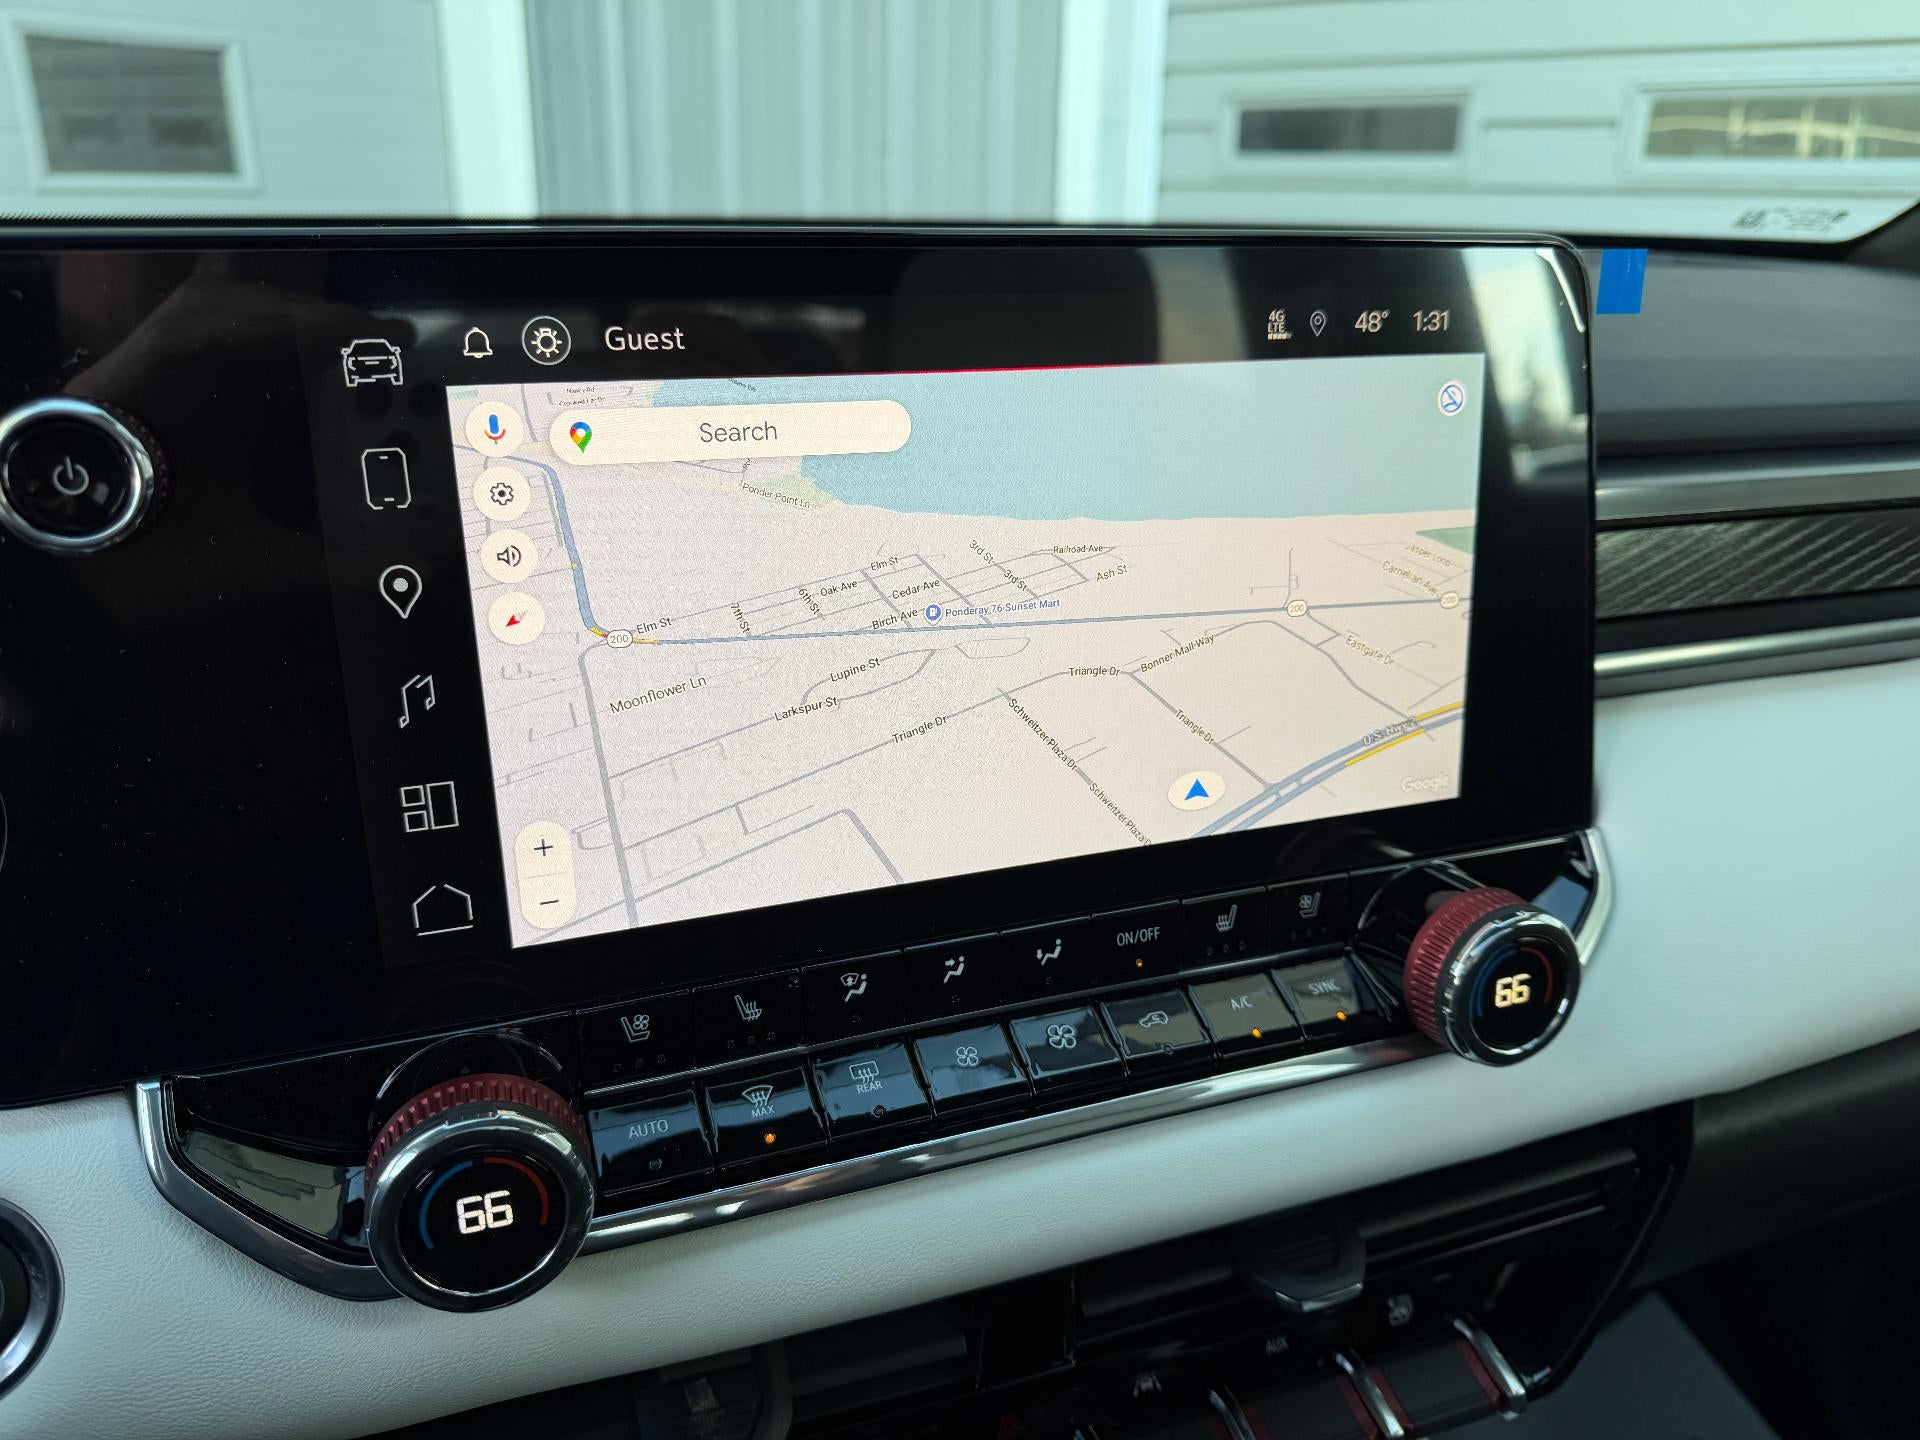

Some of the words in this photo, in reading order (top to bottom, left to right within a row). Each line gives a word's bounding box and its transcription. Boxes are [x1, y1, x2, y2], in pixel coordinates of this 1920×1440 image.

[1268, 308, 1286, 321] 4G
[1354, 309, 1391, 333] 48°
[1411, 308, 1450, 332] 1:31
[604, 325, 686, 351] Guest
[1267, 321, 1285, 333] LTE
[699, 420, 778, 443] Search
[742, 481, 773, 499] Ponder
[775, 491, 798, 506] Point
[799, 498, 811, 509] Ln
[969, 539, 987, 557] 3rd
[981, 552, 993, 565] St
[1053, 545, 1086, 554] Railroad
[1088, 544, 1104, 553] Ave
[870, 558, 889, 571] Elm
[889, 556, 899, 566] St
[1096, 569, 1115, 582] Ash
[1116, 564, 1128, 575] St
[820, 586, 838, 597] Oak
[838, 579, 858, 593] Ave
[892, 582, 920, 600] Cedar
[920, 579, 940, 592] Ave
[1003, 569, 1020, 585] 3rd
[1015, 579, 1029, 592] St
[798, 588, 814, 604] 6th
[808, 601, 821, 615] St
[945, 604, 989, 618] Ponderay
[990, 603, 1003, 614] 76
[1004, 601, 1037, 613] Sunset
[1039, 598, 1060, 610] Mart
[1290, 604, 1304, 613] 200
[636, 621, 658, 635] Elm
[659, 616, 673, 628] St
[730, 602, 744, 620] 7th
[738, 619, 750, 634] St
[871, 614, 898, 631] Birch
[899, 608, 918, 622] Ave
[610, 634, 629, 644] 200
[1345, 635, 1384, 661] Eastgate
[1384, 654, 1395, 666] Dr
[1140, 652, 1173, 673] Bonner
[1174, 641, 1195, 657] Mall
[1195, 633, 1215, 647] Way
[830, 662, 867, 683] Lupine
[868, 657, 881, 669] St
[1068, 666, 1107, 677] Triangle
[1109, 666, 1121, 676] Dr
[609, 681, 687, 715] Moonflower
[689, 676, 707, 690] Ln
[774, 702, 824, 722] Larkspur
[825, 697, 839, 708] St
[892, 719, 934, 744] Triangle
[934, 715, 947, 727] Dr
[1008, 698, 1049, 745] Schweitzer
[1048, 738, 1068, 762] Plaza
[1067, 758, 1078, 771] Dr
[1175, 708, 1205, 737] Triangle
[1204, 733, 1215, 745] Dr
[1089, 782, 1127, 823] Schweitzer
[1124, 819, 1145, 842] Plaza
[1116, 926, 1161, 947] ON/OFF
[1308, 978, 1340, 995] SYNC
[1494, 972, 1532, 1009] 66
[1230, 994, 1254, 1010] A/C
[856, 1079, 884, 1094] REAR
[751, 1104, 776, 1118] MAX
[627, 1118, 669, 1140] AUTO
[455, 1189, 514, 1235] 66
